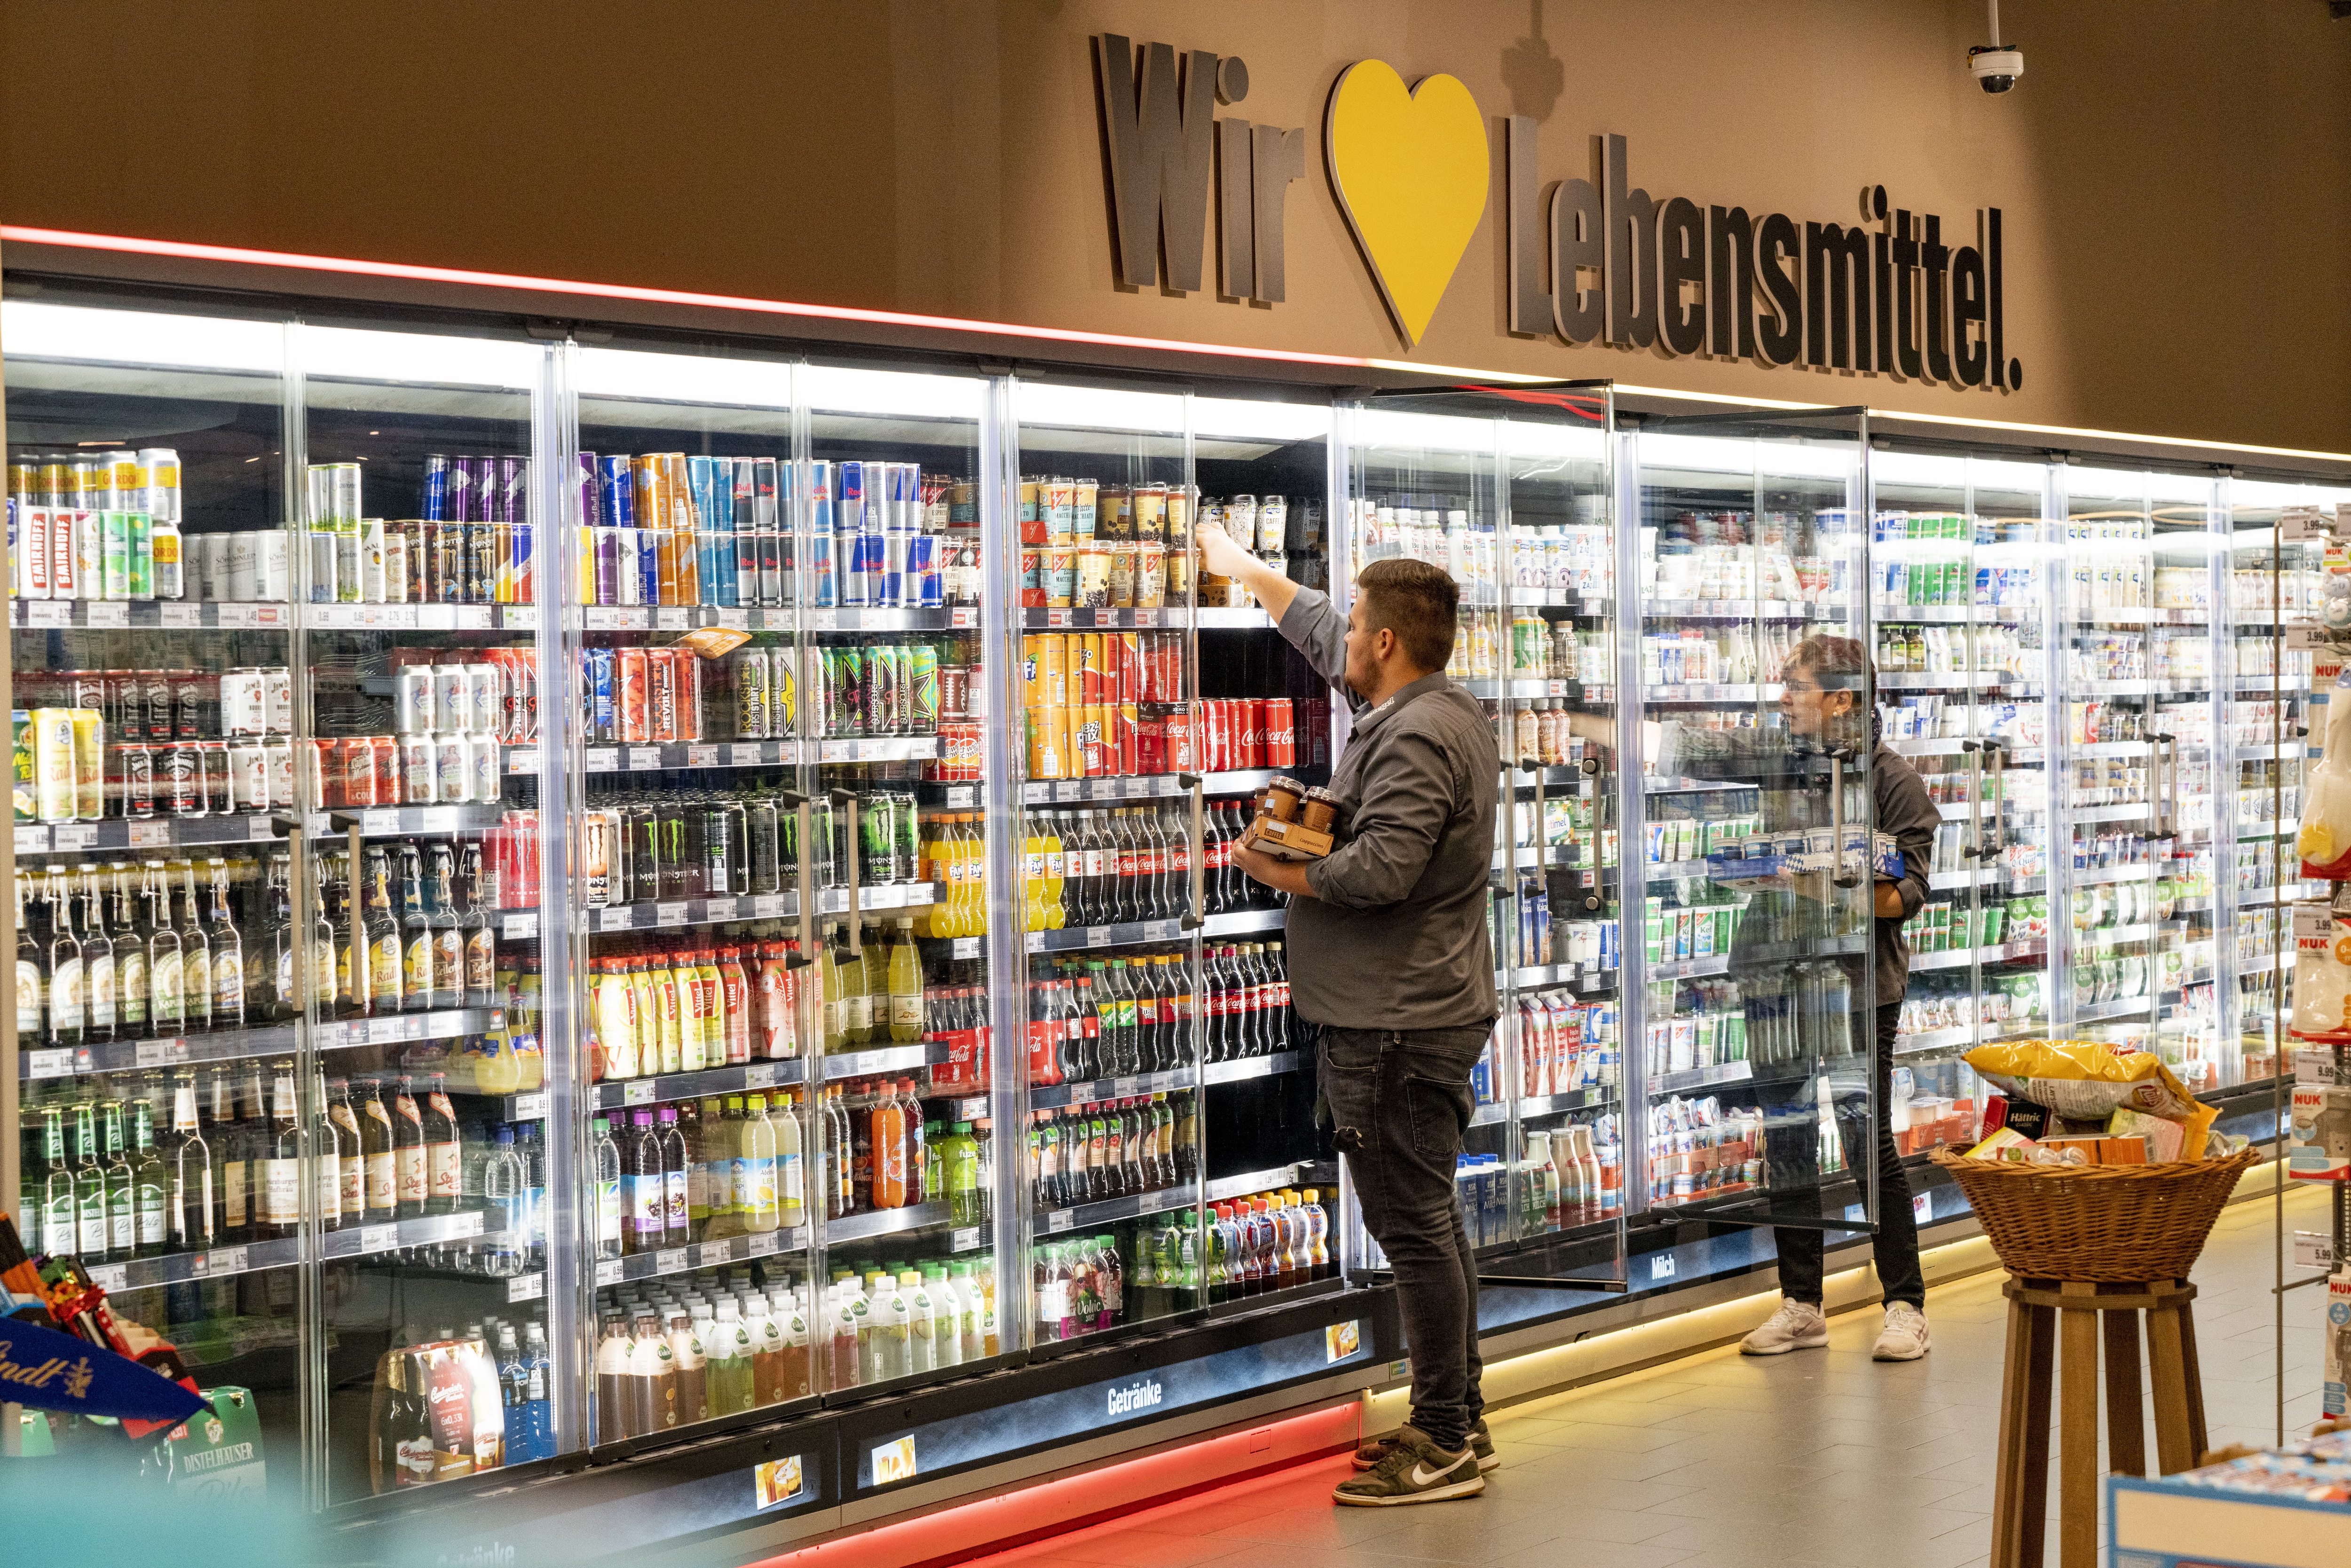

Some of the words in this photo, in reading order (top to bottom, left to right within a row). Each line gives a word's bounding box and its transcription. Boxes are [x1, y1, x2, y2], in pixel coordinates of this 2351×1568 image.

[1094, 32, 1305, 304] Wir
[1507, 114, 2023, 392] Lebensmittel.
[2304, 520, 2319, 531] 3.99
[32, 518, 46, 584] SMIRNOFF
[55, 520, 71, 584] SMIRNOFF
[2307, 631, 2323, 641] 3.99
[2316, 665, 2341, 677] NUK
[663, 688, 671, 729] REVOLT
[1265, 829, 1283, 839] COFFEE
[1299, 838, 1324, 849] Cappuccino
[2315, 920, 2331, 930] 3.99
[2299, 938, 2328, 948] NUK
[704, 986, 712, 1011] Vittel
[727, 984, 736, 1008] Vittel
[2295, 1095, 2321, 1105] NUK
[1310, 1215, 1323, 1225] Ice
[721, 1247, 729, 1255] 0.79
[2315, 1249, 2331, 1260] 5.99
[678, 1253, 686, 1263] 0.79
[613, 1266, 622, 1275] 0.59
[1652, 1252, 1675, 1279] Milch
[1077, 1300, 1101, 1314] Volvic
[1108, 1379, 1161, 1416] Getränke
